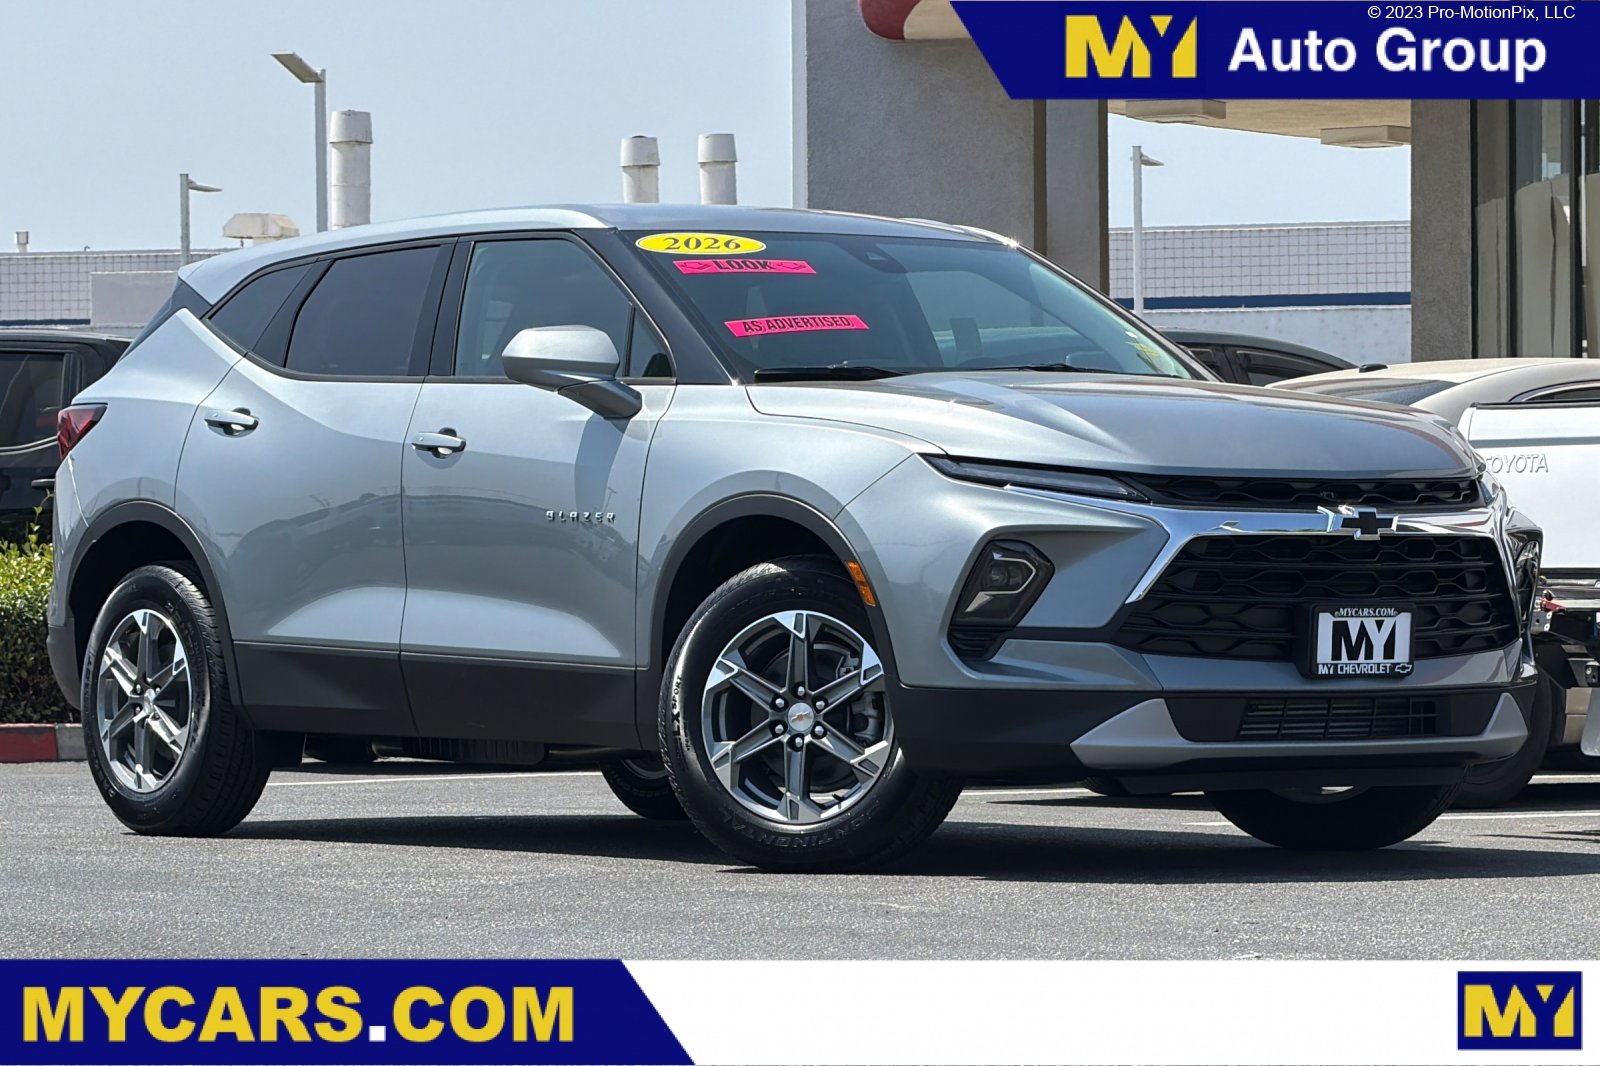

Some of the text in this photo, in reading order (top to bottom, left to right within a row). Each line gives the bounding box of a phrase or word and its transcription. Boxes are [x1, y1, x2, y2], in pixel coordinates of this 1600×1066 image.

[664, 237, 741, 250] 2026
[712, 259, 775, 271] LOOK
[743, 316, 851, 332] AS ADVERTISED
[545, 510, 616, 523] BLAZER
[1331, 620, 1396, 661] MY
[1318, 663, 1391, 674] MY CHEVROLET
[671, 674, 682, 710] SPORT
